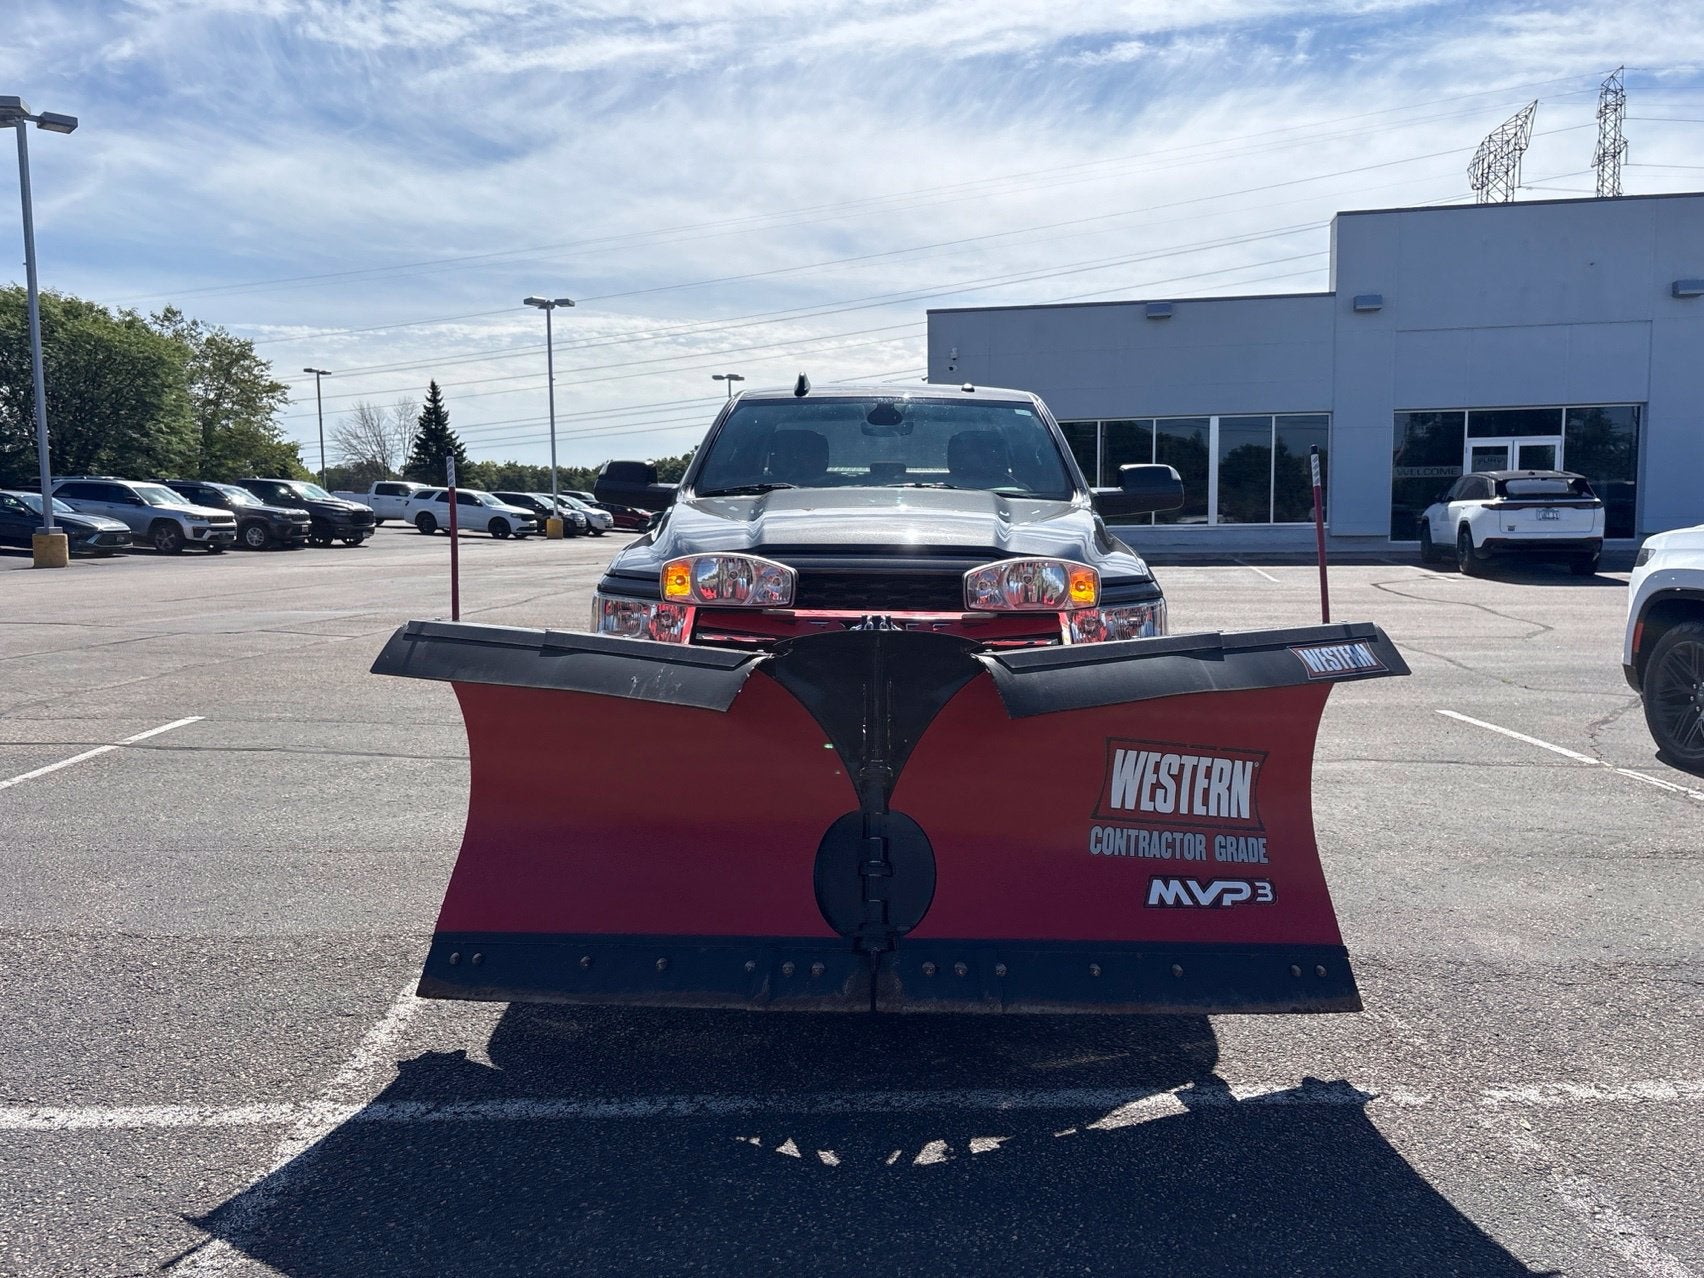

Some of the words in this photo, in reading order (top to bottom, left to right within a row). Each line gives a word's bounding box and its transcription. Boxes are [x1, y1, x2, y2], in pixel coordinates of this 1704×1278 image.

[1397, 467, 1459, 477] WELCOME
[1298, 642, 1378, 673] WESTERN
[1110, 749, 1254, 819] WESTERN
[1089, 825, 1207, 861] CONTRACTOR
[1214, 834, 1270, 864] GRADE
